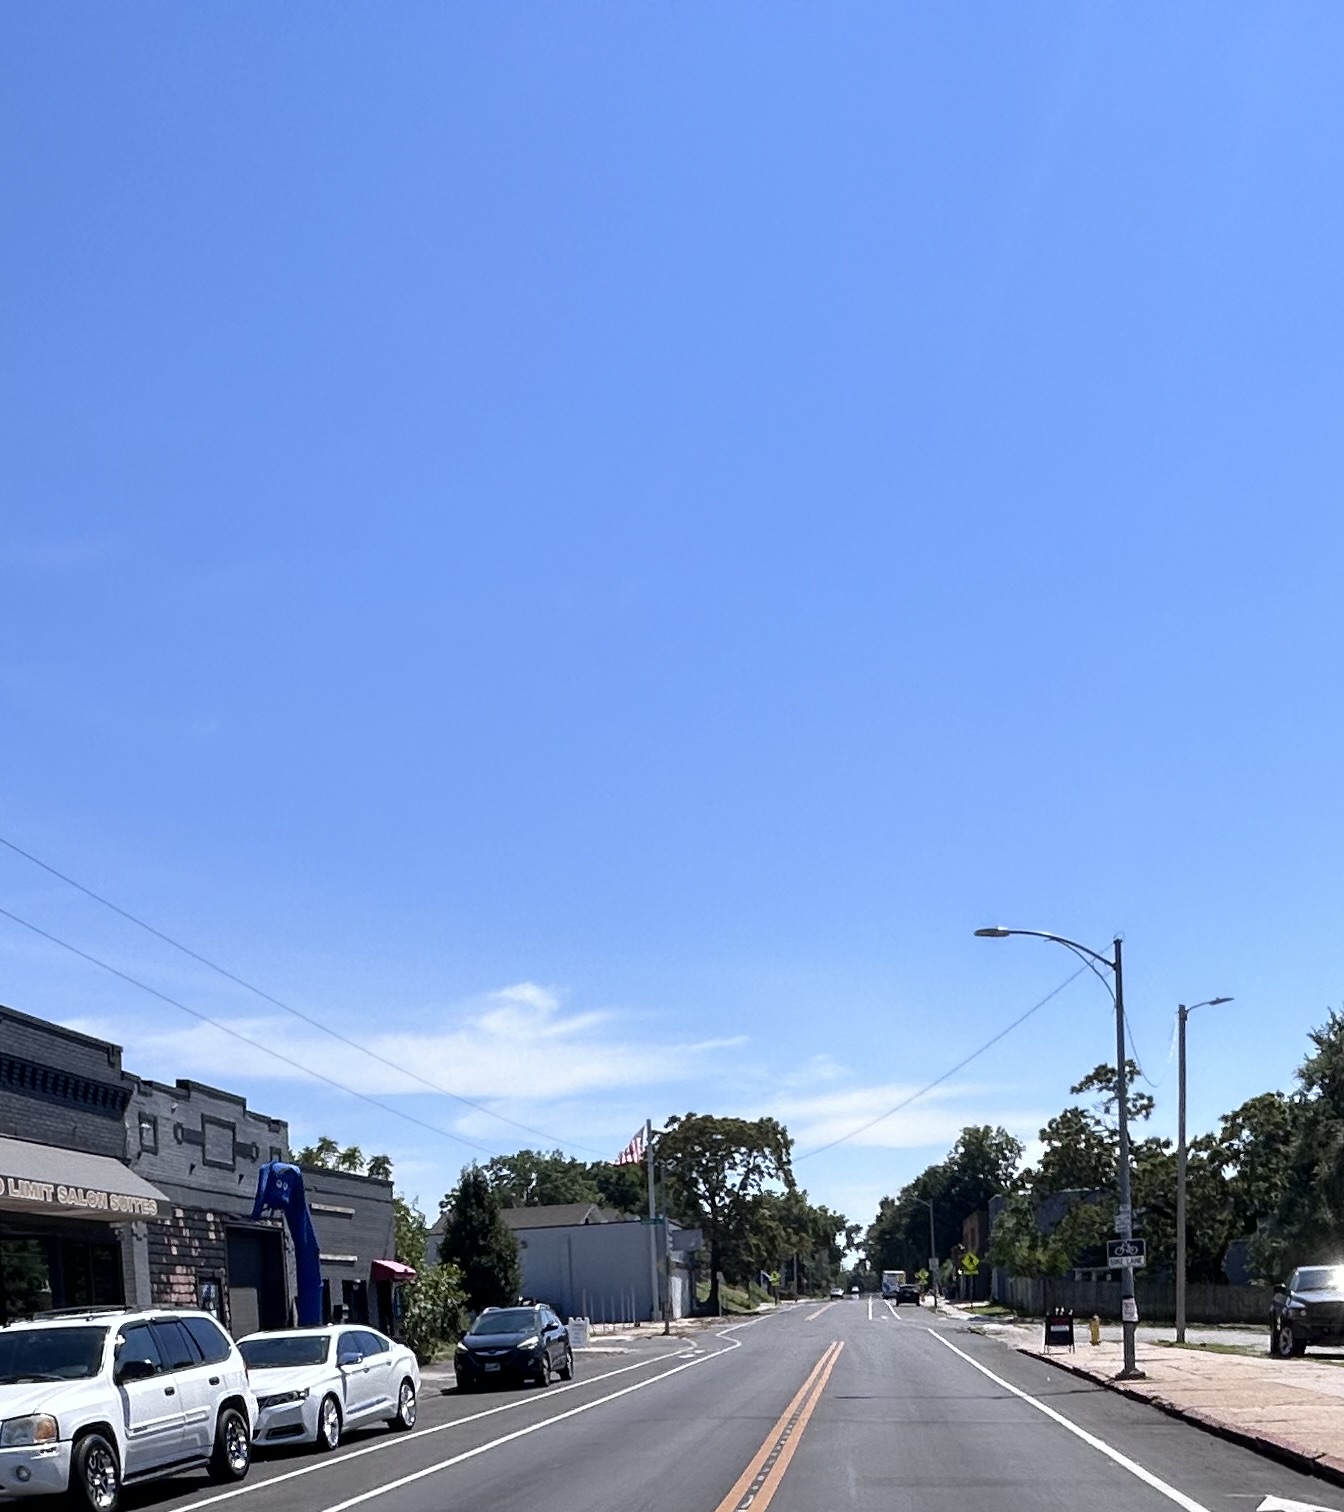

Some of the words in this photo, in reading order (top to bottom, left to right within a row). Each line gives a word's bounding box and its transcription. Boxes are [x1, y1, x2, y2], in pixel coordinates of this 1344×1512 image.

[7, 1178, 54, 1202] LIMIT
[57, 1186, 108, 1210] SALON
[109, 1193, 158, 1216] SUITES
